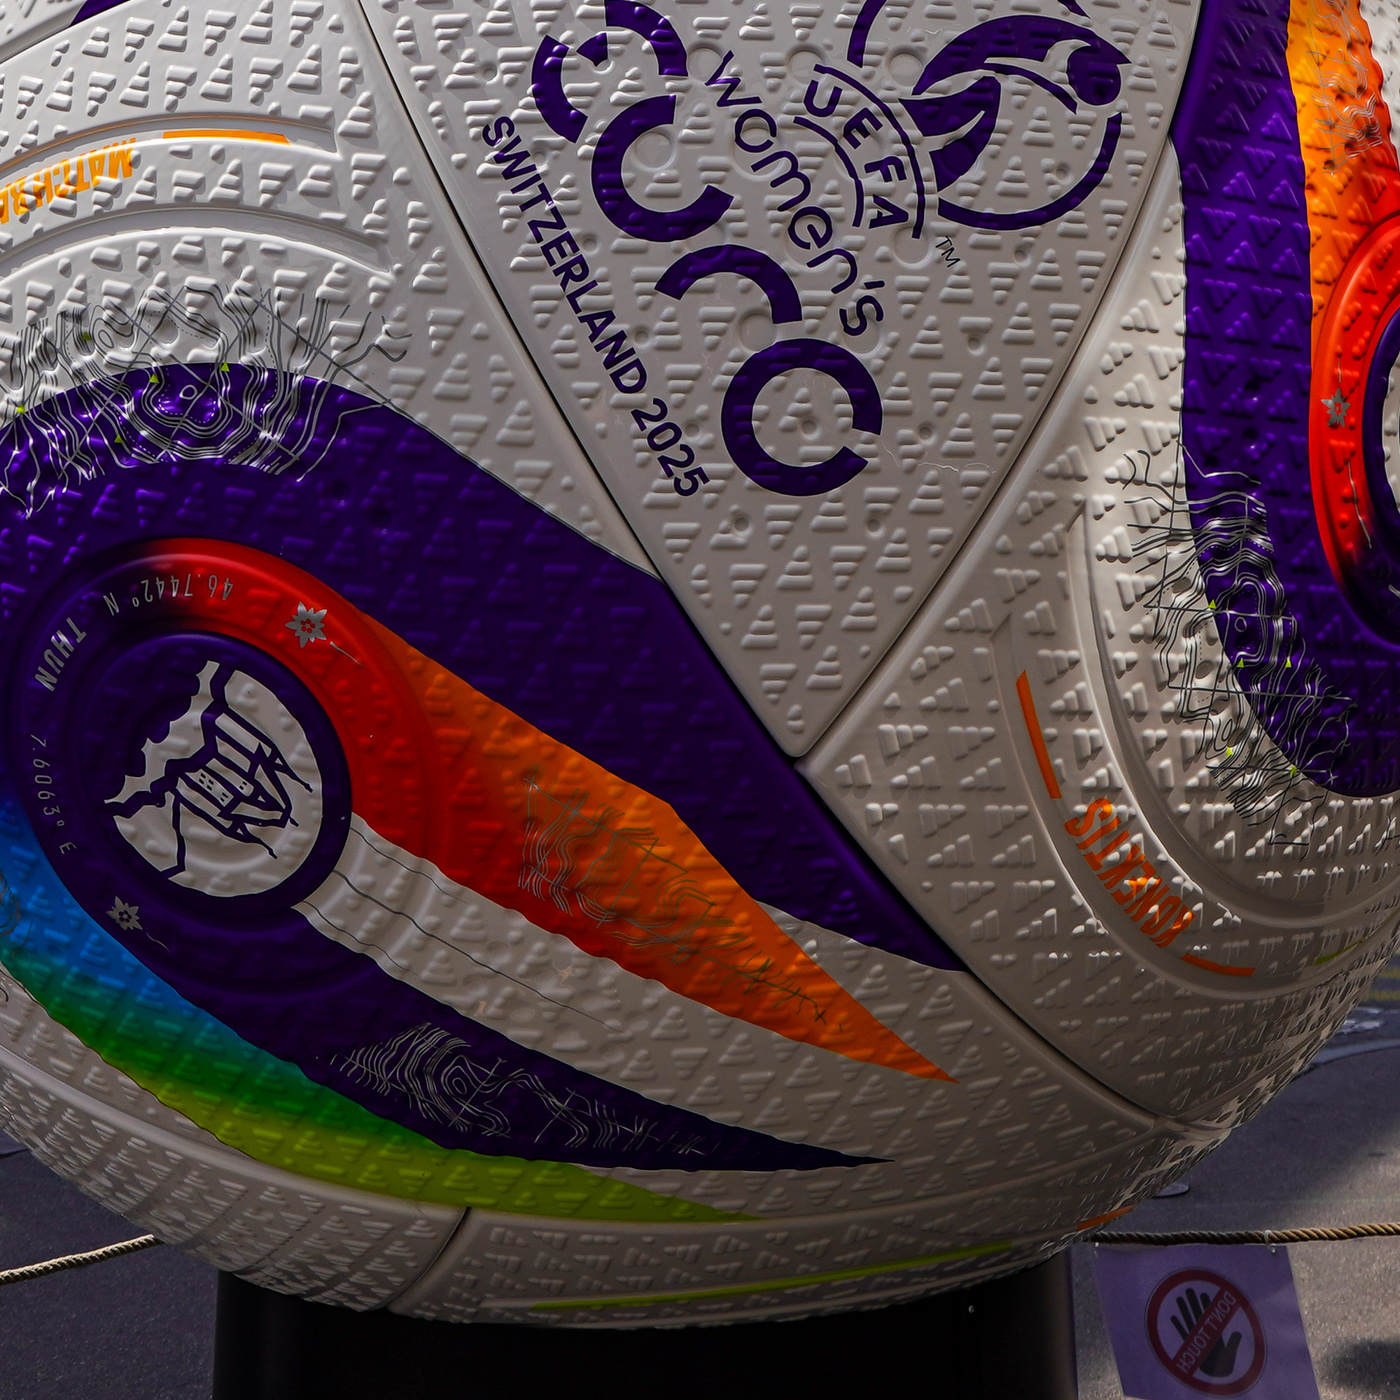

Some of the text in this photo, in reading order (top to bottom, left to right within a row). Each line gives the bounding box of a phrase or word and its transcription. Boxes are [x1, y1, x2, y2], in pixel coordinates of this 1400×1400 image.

[804, 74, 907, 231] UEFA
[482, 114, 709, 498] SWITZERLAND 2025
[34, 617, 87, 692] THUN
[1064, 798, 1195, 947] KONEKTIS
